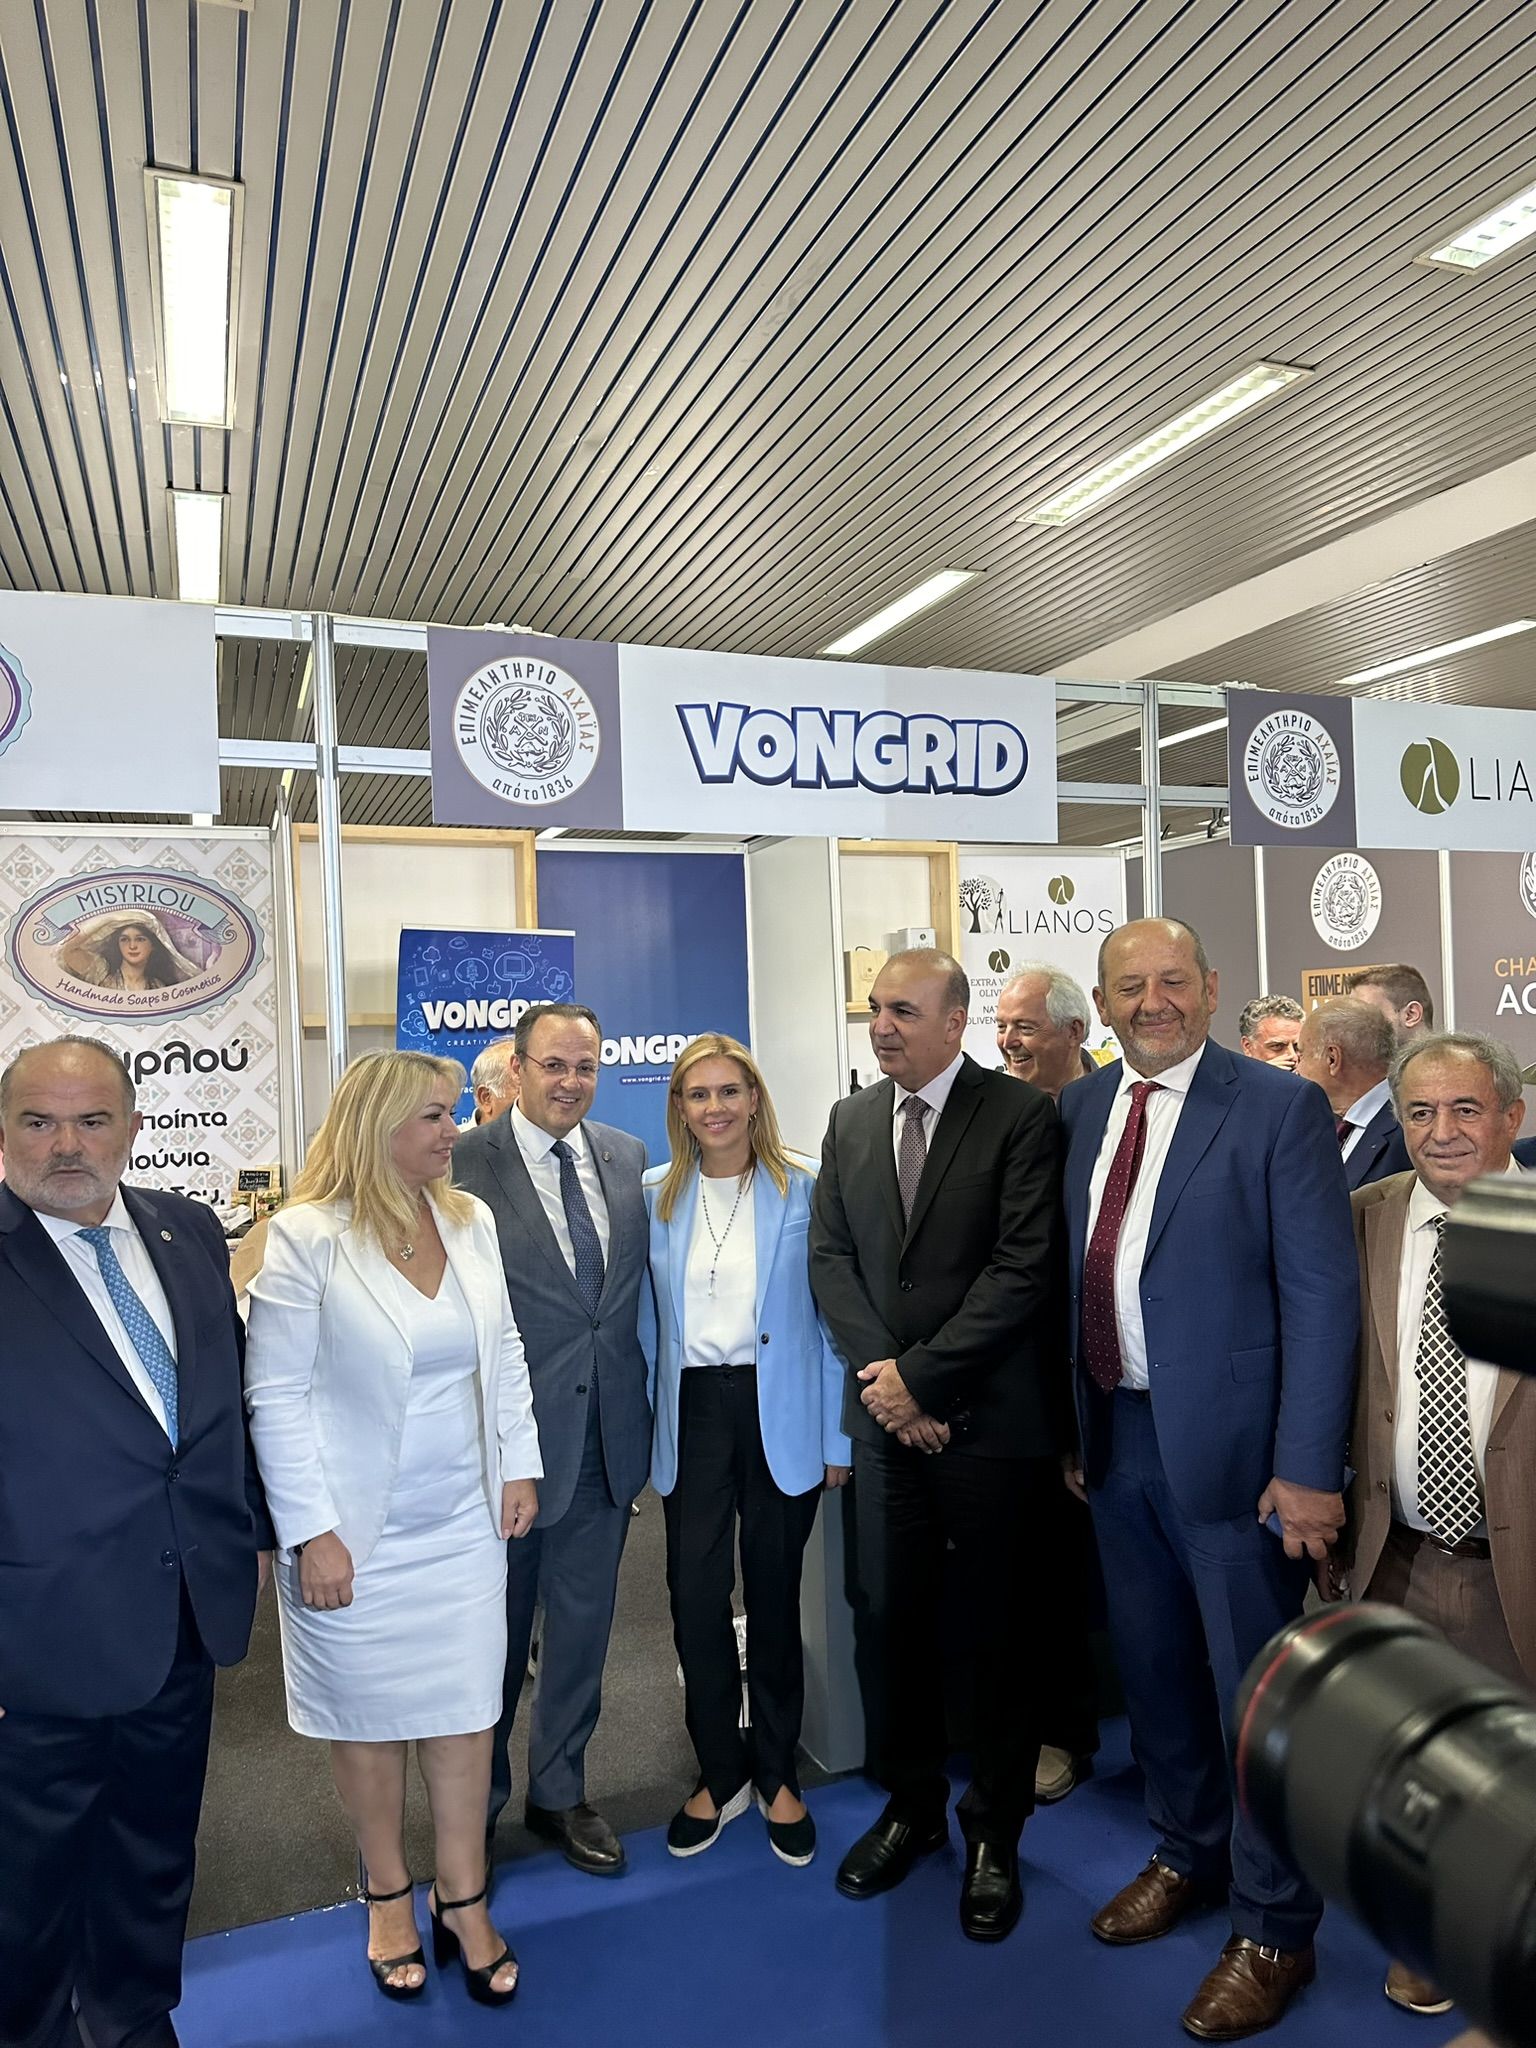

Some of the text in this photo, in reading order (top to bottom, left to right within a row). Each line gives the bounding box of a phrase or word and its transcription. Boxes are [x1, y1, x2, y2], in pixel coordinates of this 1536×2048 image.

[459, 662, 598, 753] ΕΠΙΜΕΛΗΤΗΡΙΟ ΑΧΑΪΑΣ
[675, 702, 1028, 796] VONGRID
[1247, 714, 1312, 782] ΕΠΙΜΕΛΗΤΗΡΙΟ
[1470, 756, 1534, 802] LIA
[76, 884, 196, 913] MISYRLOU
[1008, 909, 1115, 934] LIANOS
[970, 978, 998, 987] EXTRA
[1494, 956, 1536, 977] CHA
[56, 977, 124, 1005] Handmade
[127, 994, 160, 1008] Soaps
[171, 972, 223, 1001] Cosmetics
[1308, 973, 1355, 997] ΕΠΙΜΕΛ
[421, 999, 554, 1031] VONGR
[600, 1034, 704, 1066] ONGR
[621, 1075, 671, 1083] www.vongrid.co
